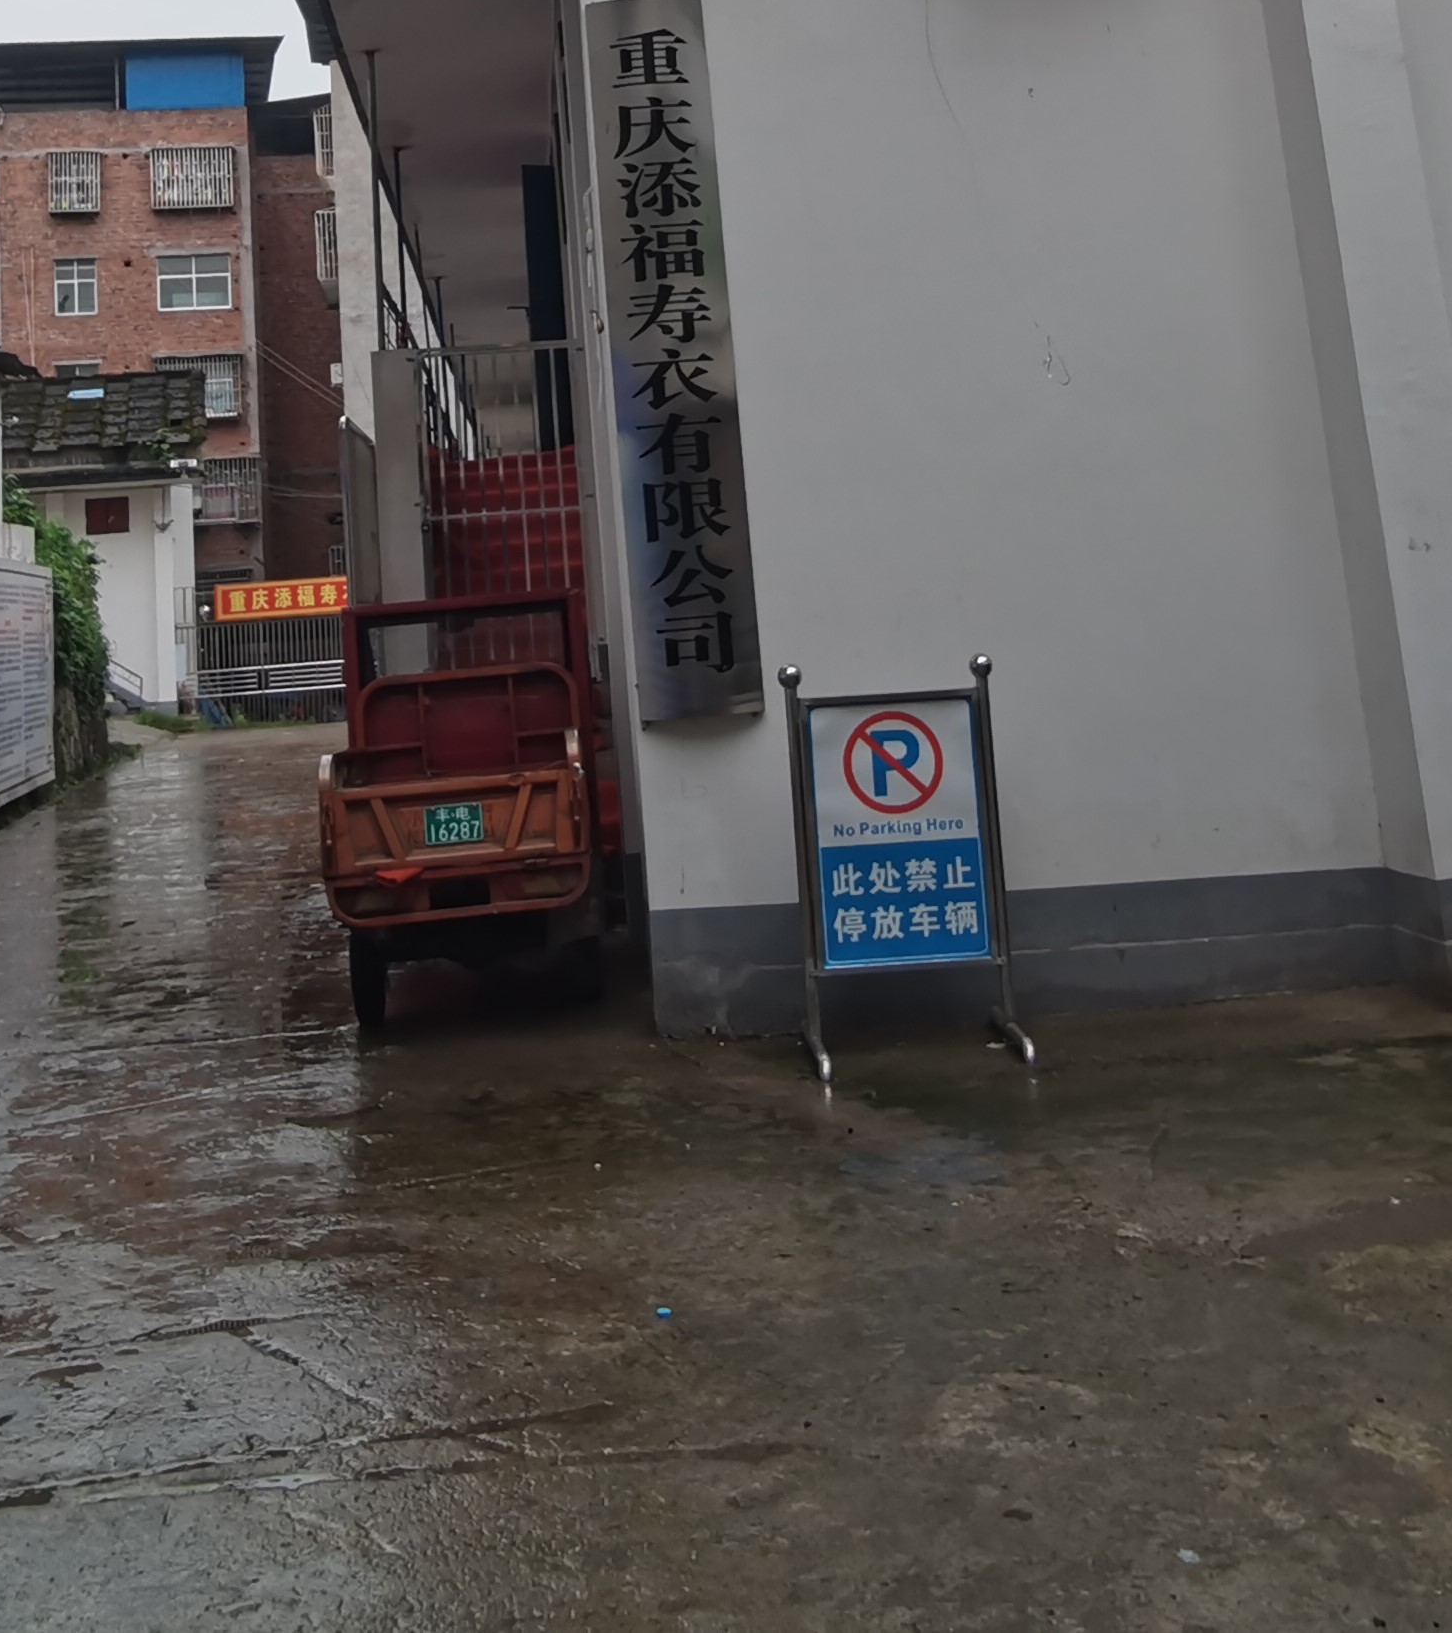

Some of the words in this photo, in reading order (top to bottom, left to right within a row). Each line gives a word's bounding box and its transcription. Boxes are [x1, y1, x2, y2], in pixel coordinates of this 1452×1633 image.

[609, 29, 735, 673] 重庆添福寿衣有限公司
[229, 583, 347, 612] 重庆添福寿
[430, 820, 480, 843] 16287
[833, 823, 856, 837] No
[860, 820, 922, 837] Parking
[926, 817, 964, 832] Here
[832, 856, 976, 897] 此处禁止
[833, 901, 979, 943] 停放车辆
